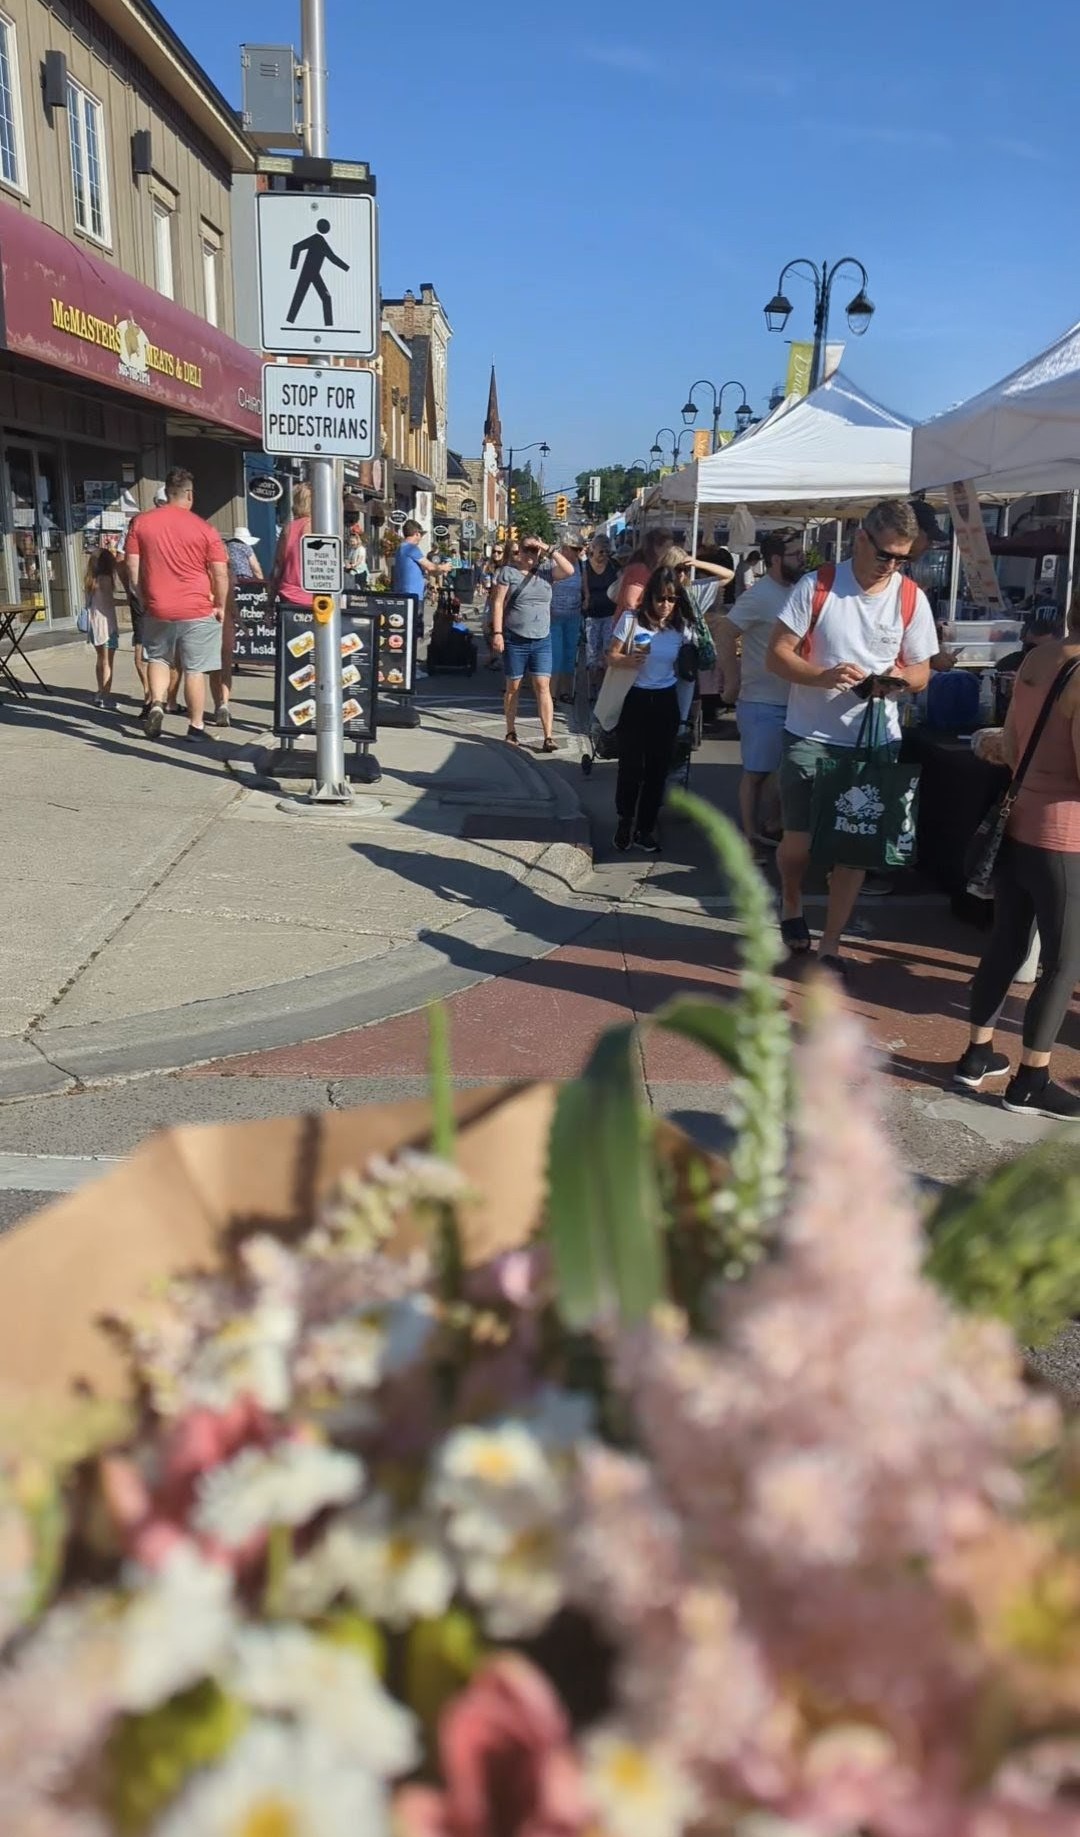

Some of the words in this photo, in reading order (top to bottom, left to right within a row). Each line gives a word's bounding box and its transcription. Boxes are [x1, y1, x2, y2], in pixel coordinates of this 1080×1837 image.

[51, 298, 121, 354] McMASTER'S
[145, 343, 174, 377] MEATS
[175, 357, 182, 380] &
[183, 360, 202, 388] DELI
[282, 384, 318, 407] STOP
[327, 386, 355, 410] FOR
[269, 413, 368, 440] PEDESTRIANS
